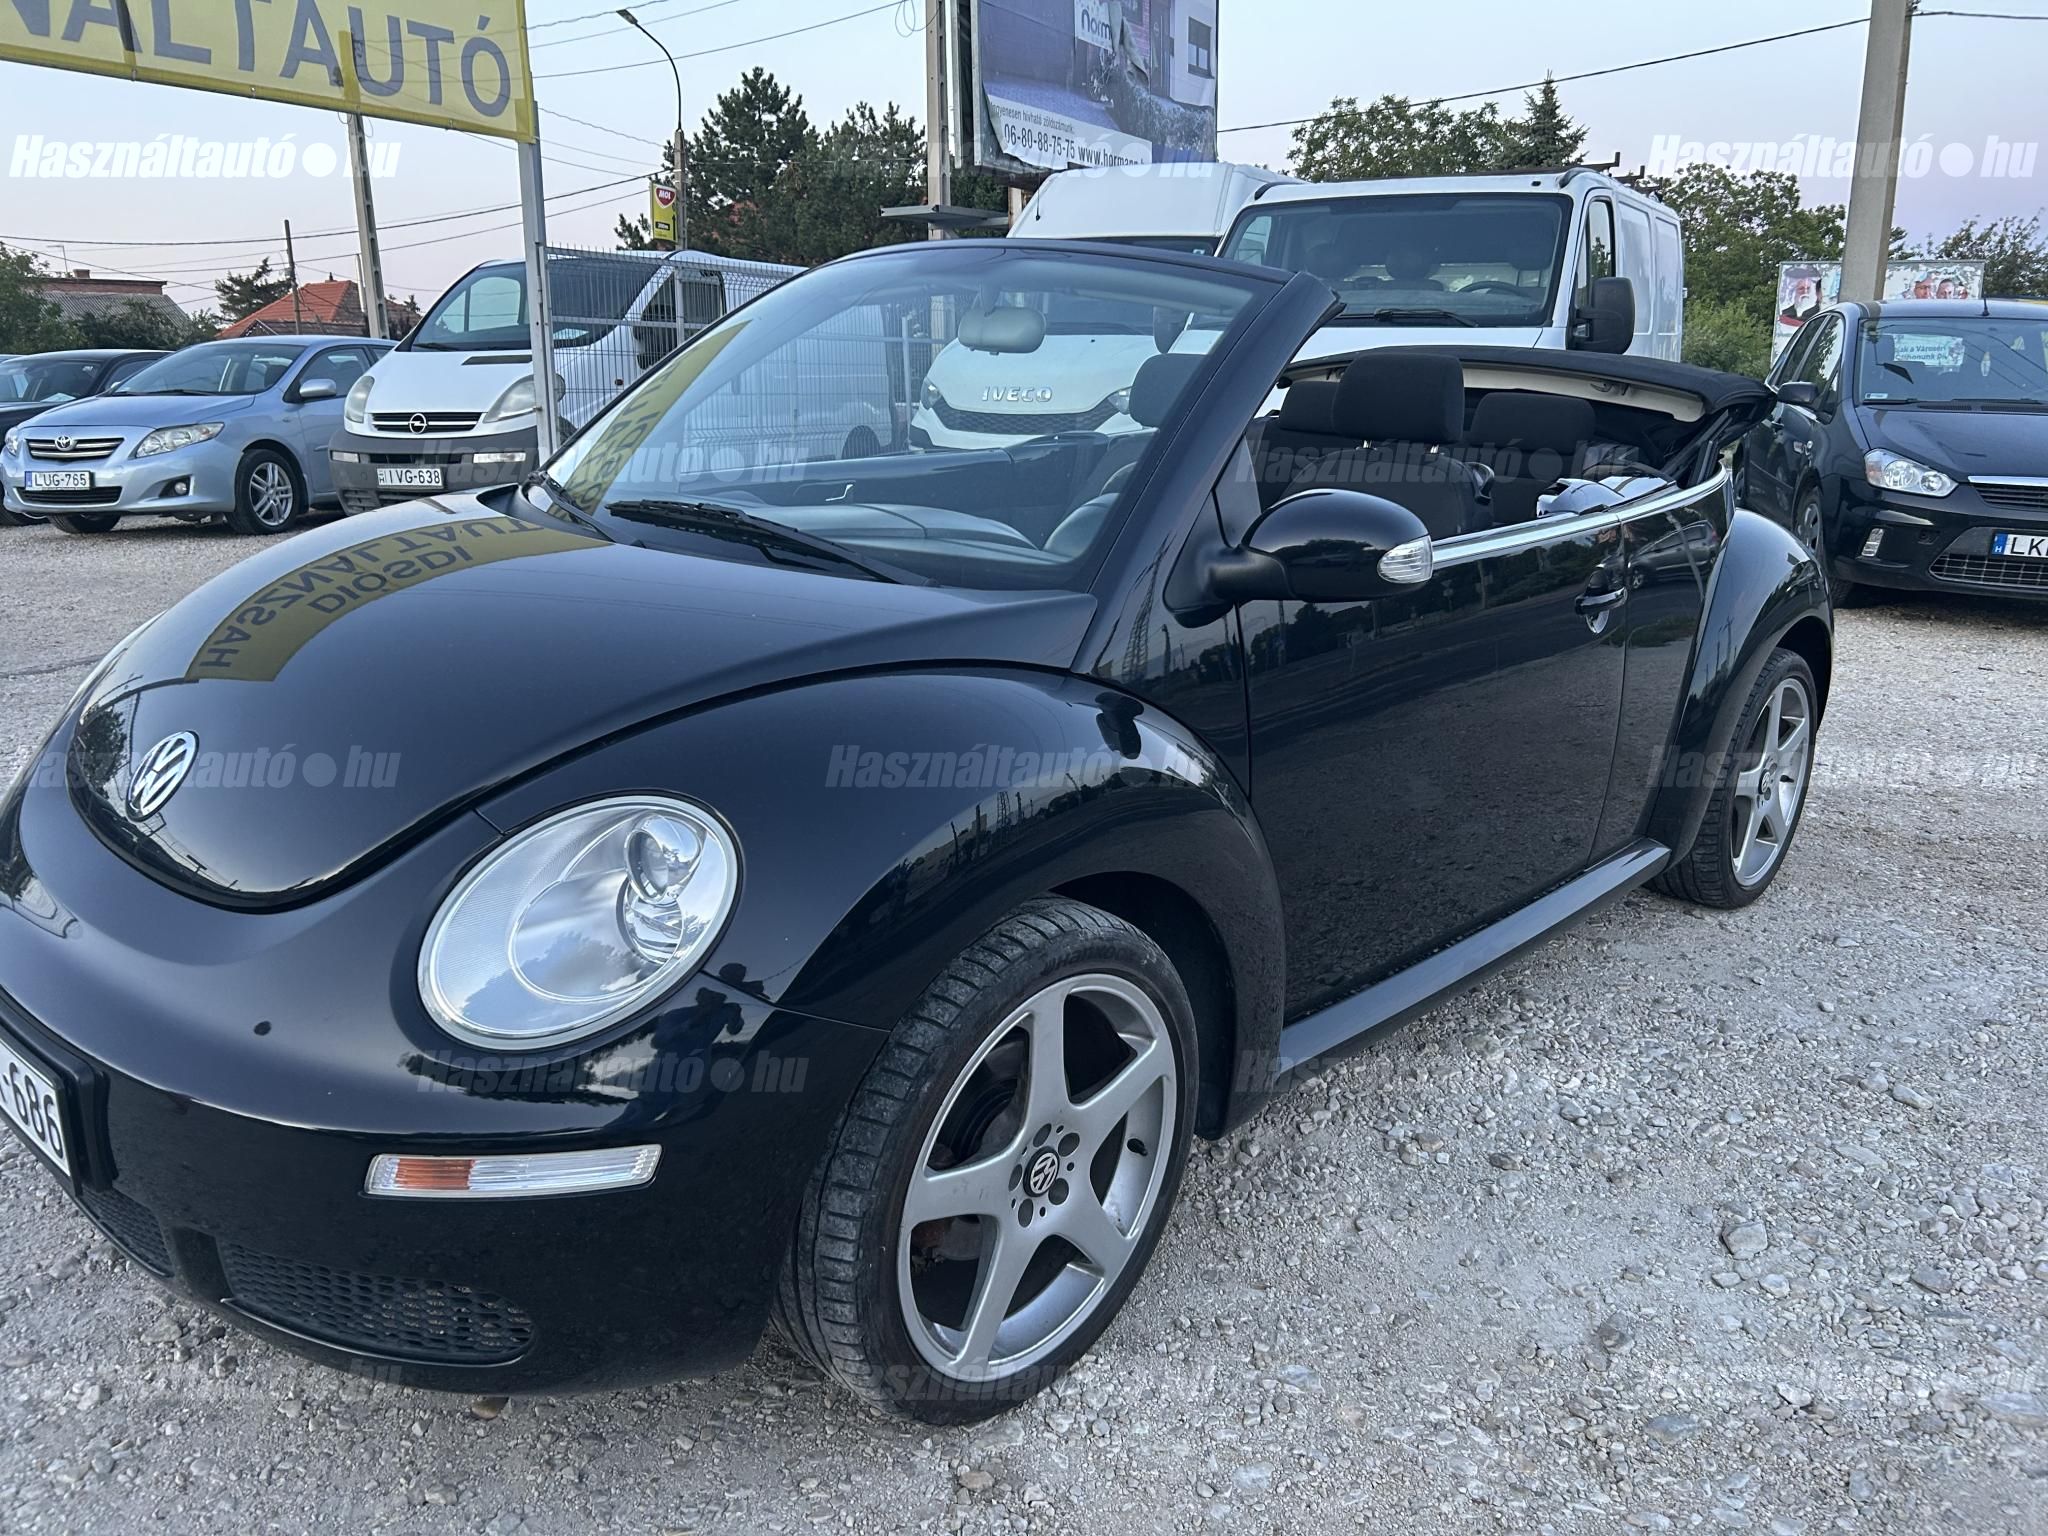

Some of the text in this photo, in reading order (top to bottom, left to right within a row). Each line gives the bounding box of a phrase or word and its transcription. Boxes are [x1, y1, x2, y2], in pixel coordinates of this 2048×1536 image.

[1004, 123, 1075, 160] 06-80-88-75-75
[982, 386, 1053, 402] IVECO
[35, 473, 87, 486] LUG-765
[389, 469, 440, 484] IVG-638
[2010, 536, 2048, 556] LK
[0, 1062, 63, 1158] -686
